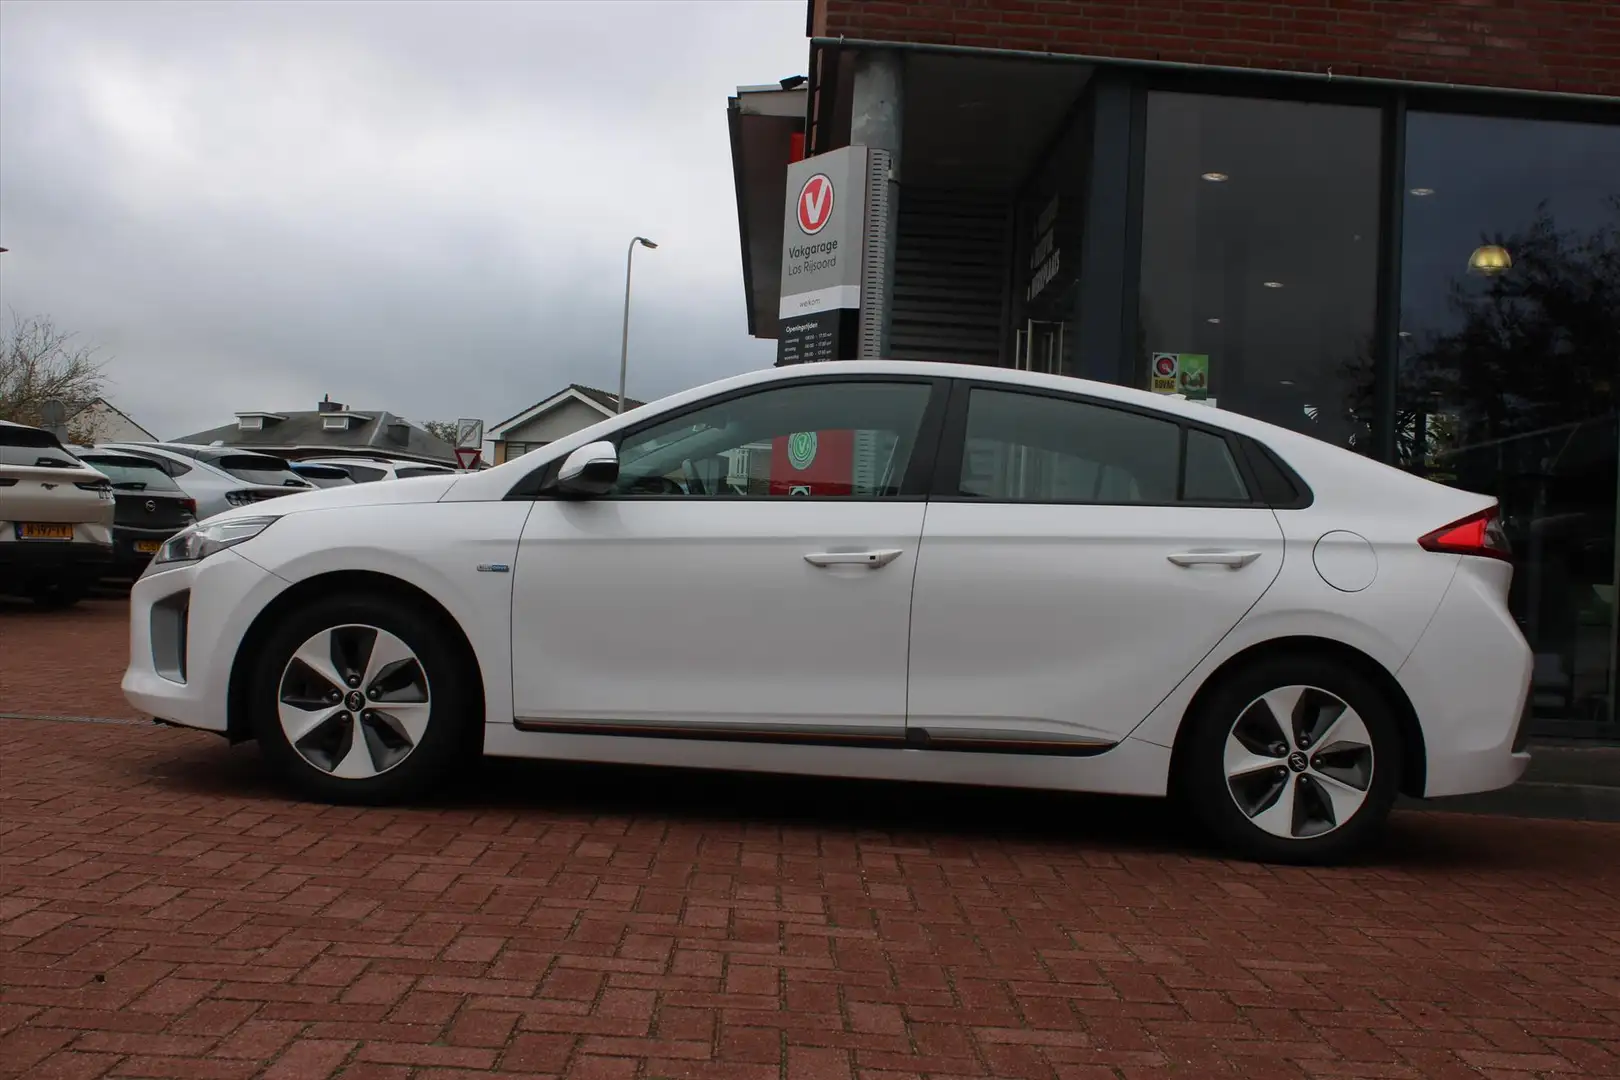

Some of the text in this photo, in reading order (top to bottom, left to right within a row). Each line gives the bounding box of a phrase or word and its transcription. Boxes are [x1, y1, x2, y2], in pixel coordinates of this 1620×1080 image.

[805, 177, 829, 224] V
[788, 239, 838, 260] Vakgarage
[788, 256, 837, 276] Los Rijsoord
